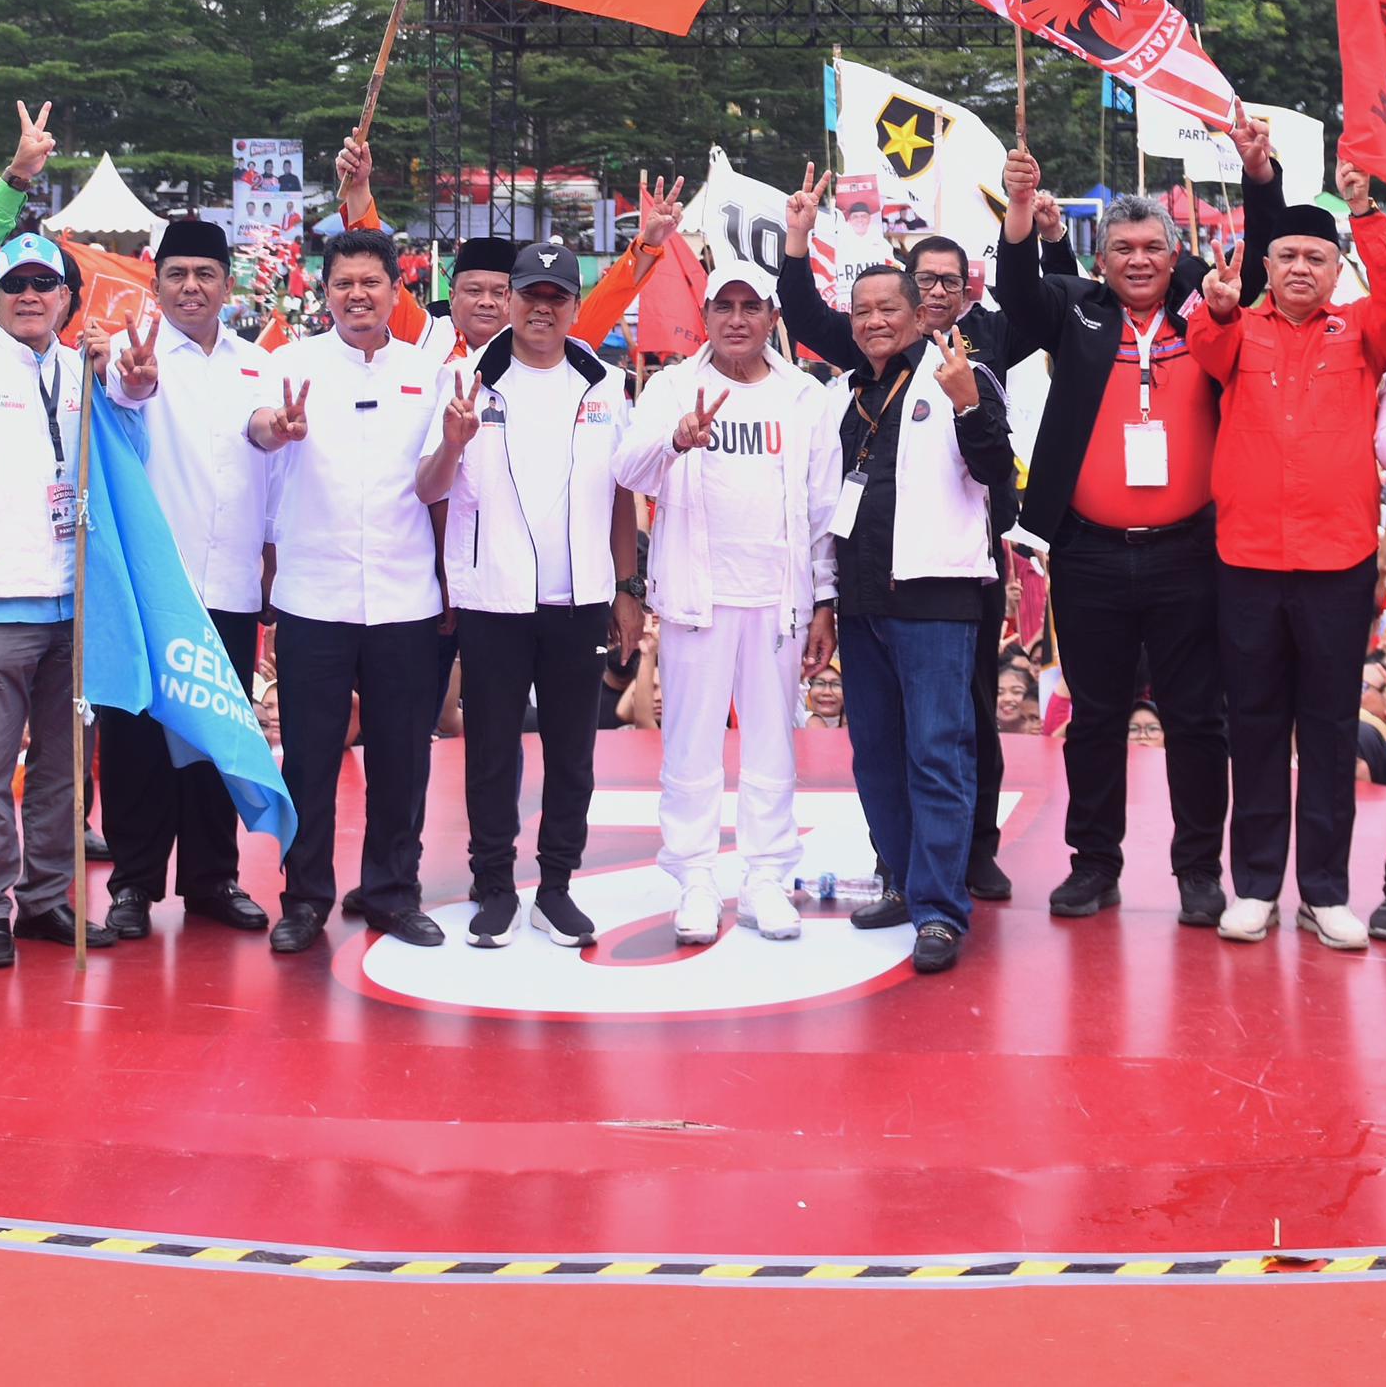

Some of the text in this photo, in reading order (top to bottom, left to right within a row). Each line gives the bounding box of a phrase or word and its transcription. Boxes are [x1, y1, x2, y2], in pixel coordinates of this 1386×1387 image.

[1178, 128, 1214, 142] PARTA
[719, 200, 788, 277] 10
[165, 637, 245, 699] GELO
[160, 673, 261, 736] INDONE
